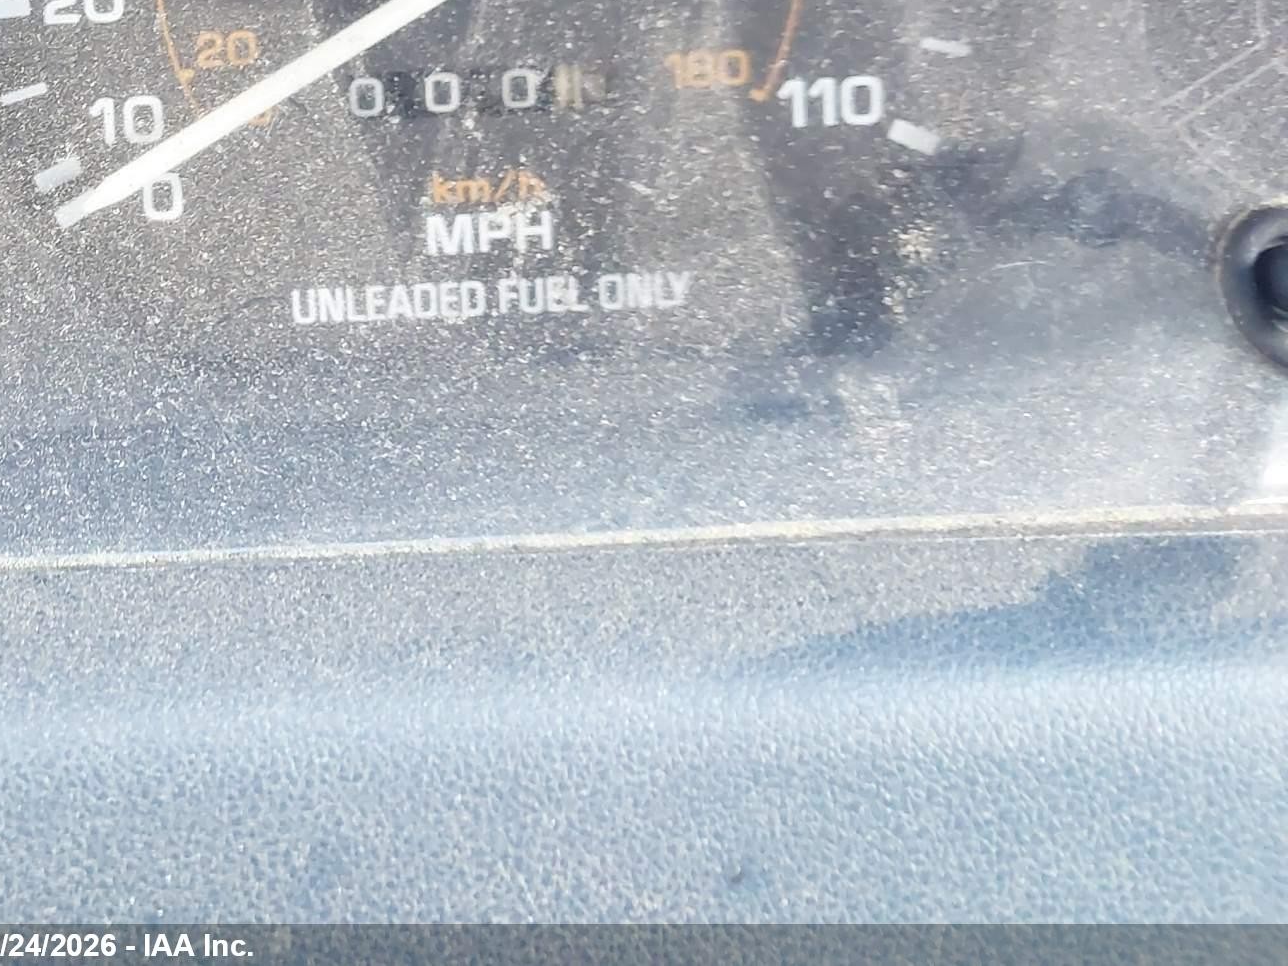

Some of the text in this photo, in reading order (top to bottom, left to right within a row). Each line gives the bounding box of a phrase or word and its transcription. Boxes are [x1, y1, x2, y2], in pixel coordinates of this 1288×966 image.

[195, 29, 260, 69] 20
[663, 49, 751, 90] 180
[89, 94, 165, 147] 10
[777, 75, 885, 128] 110
[141, 172, 185, 222] 0
[430, 168, 548, 206] km/h
[425, 210, 554, 257] MPH
[290, 270, 693, 326] UNLEADED FUEL ONLY
